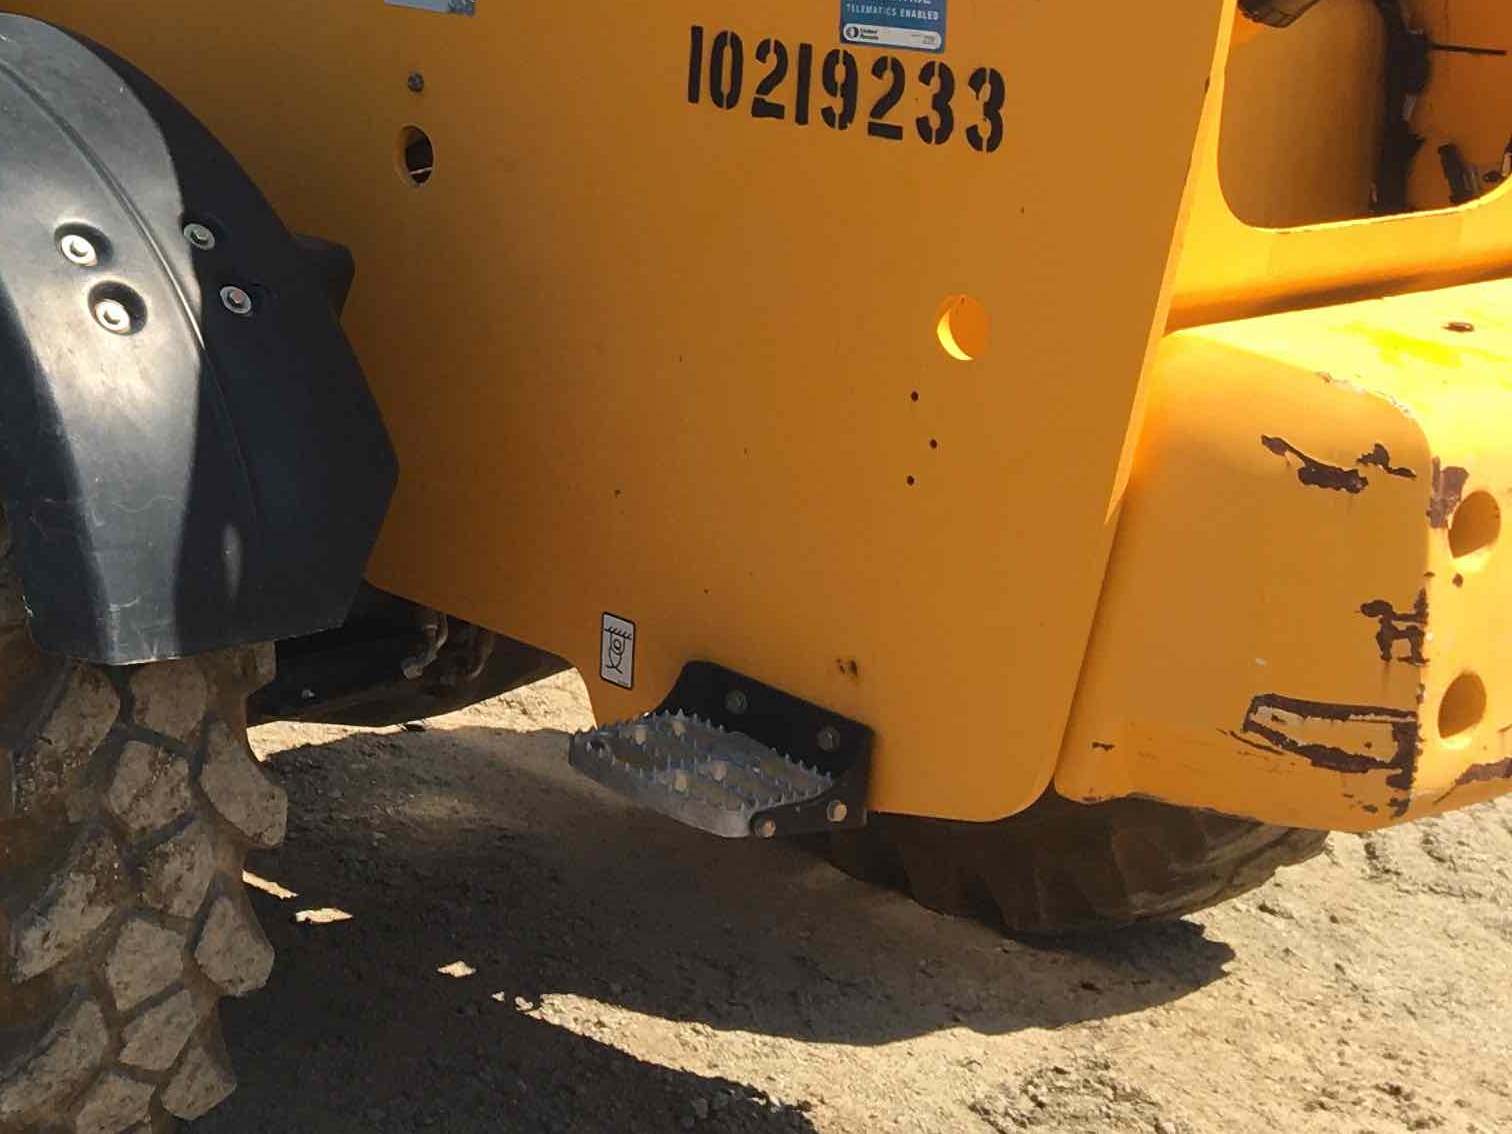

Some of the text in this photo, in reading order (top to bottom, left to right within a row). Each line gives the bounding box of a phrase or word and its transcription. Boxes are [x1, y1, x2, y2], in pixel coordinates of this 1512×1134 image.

[846, 3, 939, 21] TELEMATICS ENABLED
[687, 25, 1006, 153] 10219233
